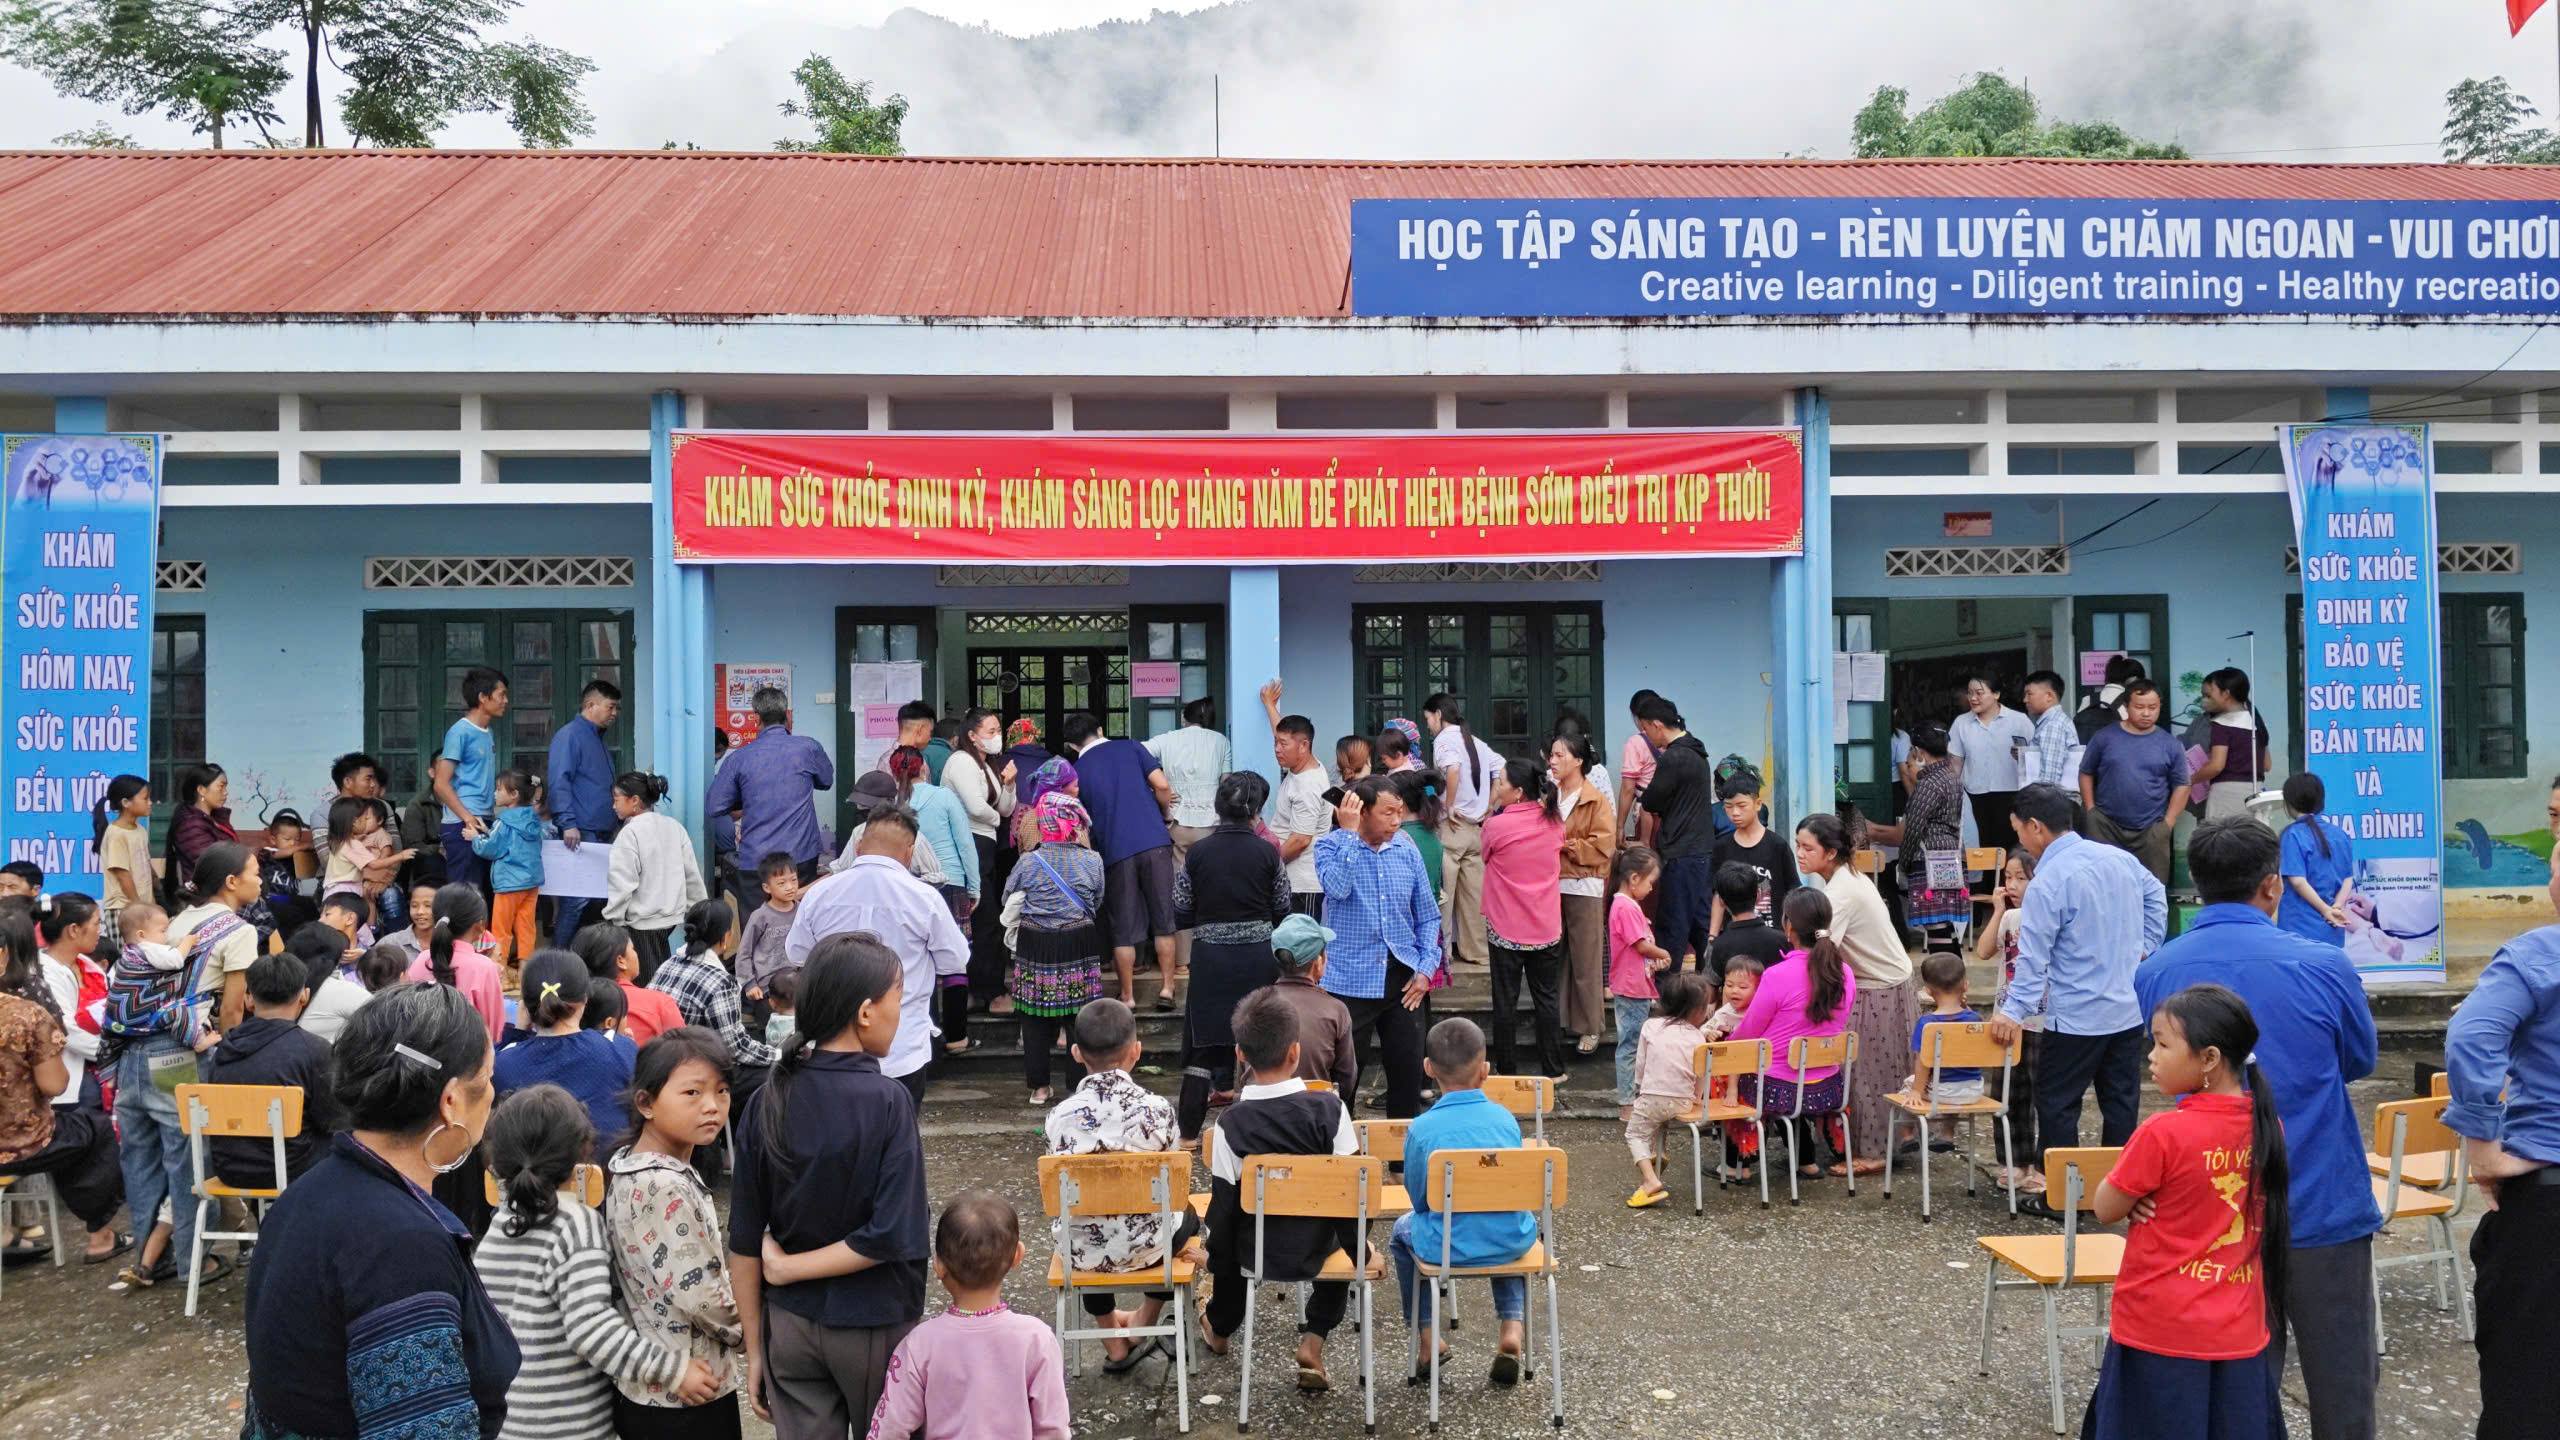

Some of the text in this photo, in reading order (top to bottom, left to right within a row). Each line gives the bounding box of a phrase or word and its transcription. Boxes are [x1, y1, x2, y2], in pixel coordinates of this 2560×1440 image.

[1399, 219, 1482, 270] HỌC
[1497, 210, 1575, 268] TẬP
[1591, 209, 1705, 259] SÁNG
[1720, 218, 1798, 267] TẠO
[1840, 208, 1922, 257] RÈN
[1937, 208, 2064, 266] LUYỆN
[2083, 209, 2200, 257] CHĂM
[2216, 219, 2353, 258] NGOAN
[2390, 220, 2452, 258] VUI
[2467, 214, 2560, 258] CHƠI
[1641, 270, 1783, 301] Creative
[1797, 270, 1936, 308] learning
[1973, 265, 2102, 306] Diligent
[2114, 270, 2242, 306] training
[2280, 270, 2403, 307] Healthy
[2417, 271, 2560, 300] recreatio
[705, 457, 1770, 540] KHÁM SỨC KHỎE ĐỊNH KỲ, KHÁM SÀNG LỌC HÀNG NĂM ĐỂ PHÁT HIỆN BỆNH SỚM ĐIỀU TRỊ KỊP THỜI!
[2328, 508, 2394, 537] KHÁM
[44, 525, 115, 567] KHÁM
[2308, 548, 2418, 581] SỨC KHỎE
[18, 582, 139, 628] SỨC KHỎE
[2317, 593, 2408, 629] ĐỊNH KỲ
[21, 647, 135, 694] HÔM NAY,
[2325, 634, 2404, 671] BẢO VỆ
[2309, 676, 2422, 711] SỨC KHỎE
[17, 704, 138, 751] SỨC KHỎE
[2309, 720, 2424, 753] BẢN THÂN
[16, 766, 63, 811] BỀN
[2355, 766, 2382, 795] VÀ
[2361, 809, 2424, 838] ĐÌNH!
[10, 831, 75, 873] NGÀY
[2203, 1147, 2230, 1170] TÔI
[2180, 1258, 2226, 1283] VIỆT
